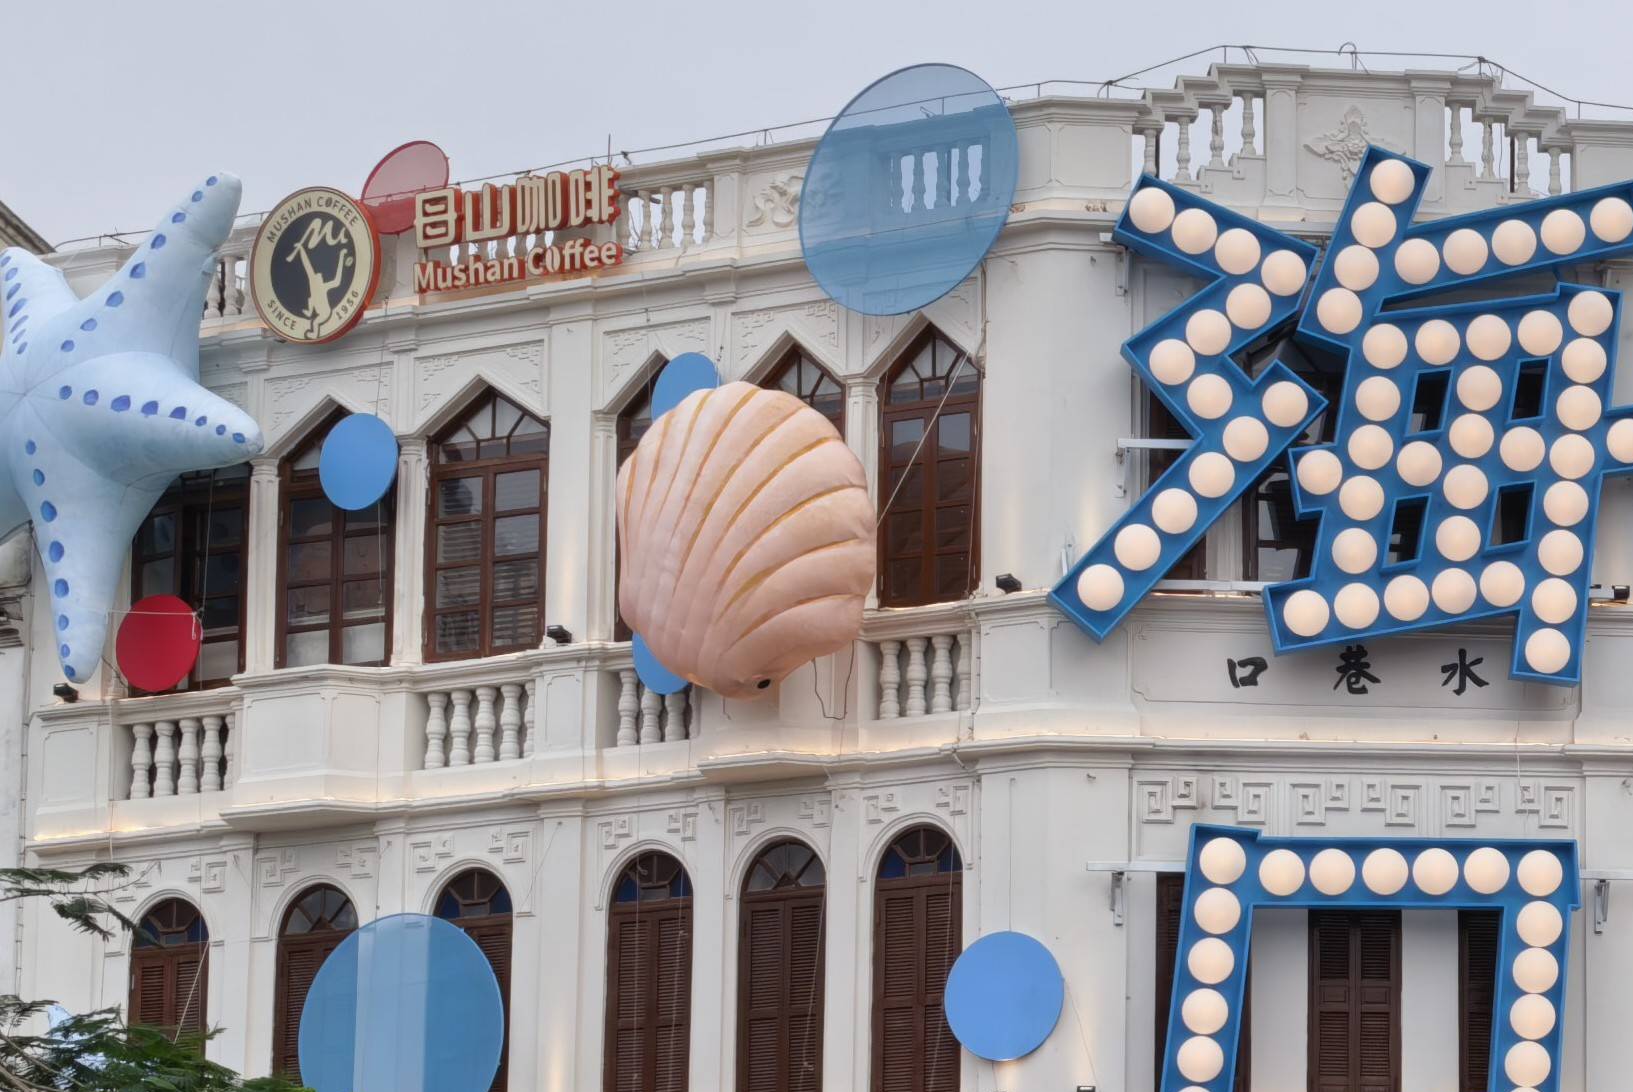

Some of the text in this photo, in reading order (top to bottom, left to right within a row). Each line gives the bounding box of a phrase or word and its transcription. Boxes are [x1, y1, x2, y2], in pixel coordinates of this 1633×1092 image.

[266, 197, 312, 243] MUSHAN
[316, 196, 360, 227] COFFEE
[414, 238, 618, 292] Mushan Coffee
[267, 299, 297, 331] SINCE
